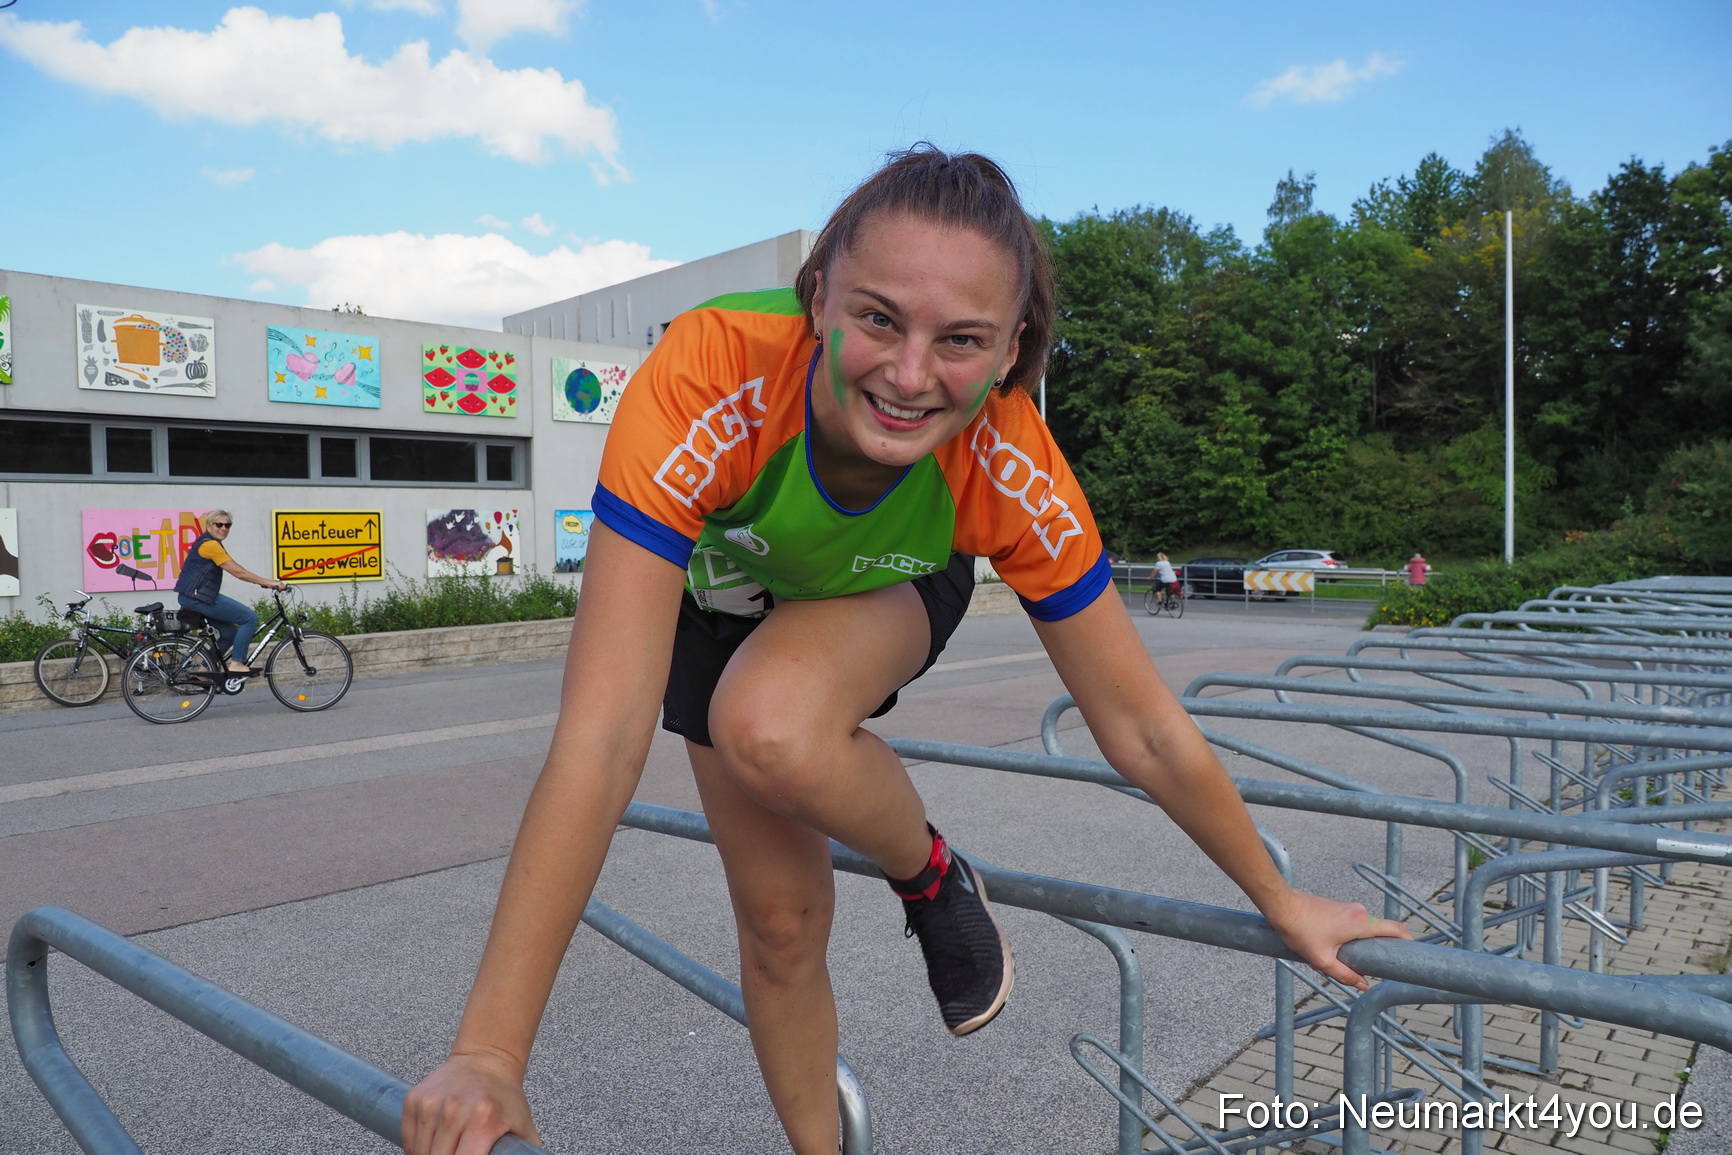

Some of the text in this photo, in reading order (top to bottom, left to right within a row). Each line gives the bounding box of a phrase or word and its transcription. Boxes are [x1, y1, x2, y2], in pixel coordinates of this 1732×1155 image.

[653, 376, 768, 509] BOCK
[281, 520, 363, 540] Abenteuer
[281, 552, 378, 575] Langeweile
[852, 553, 937, 575] BOCK
